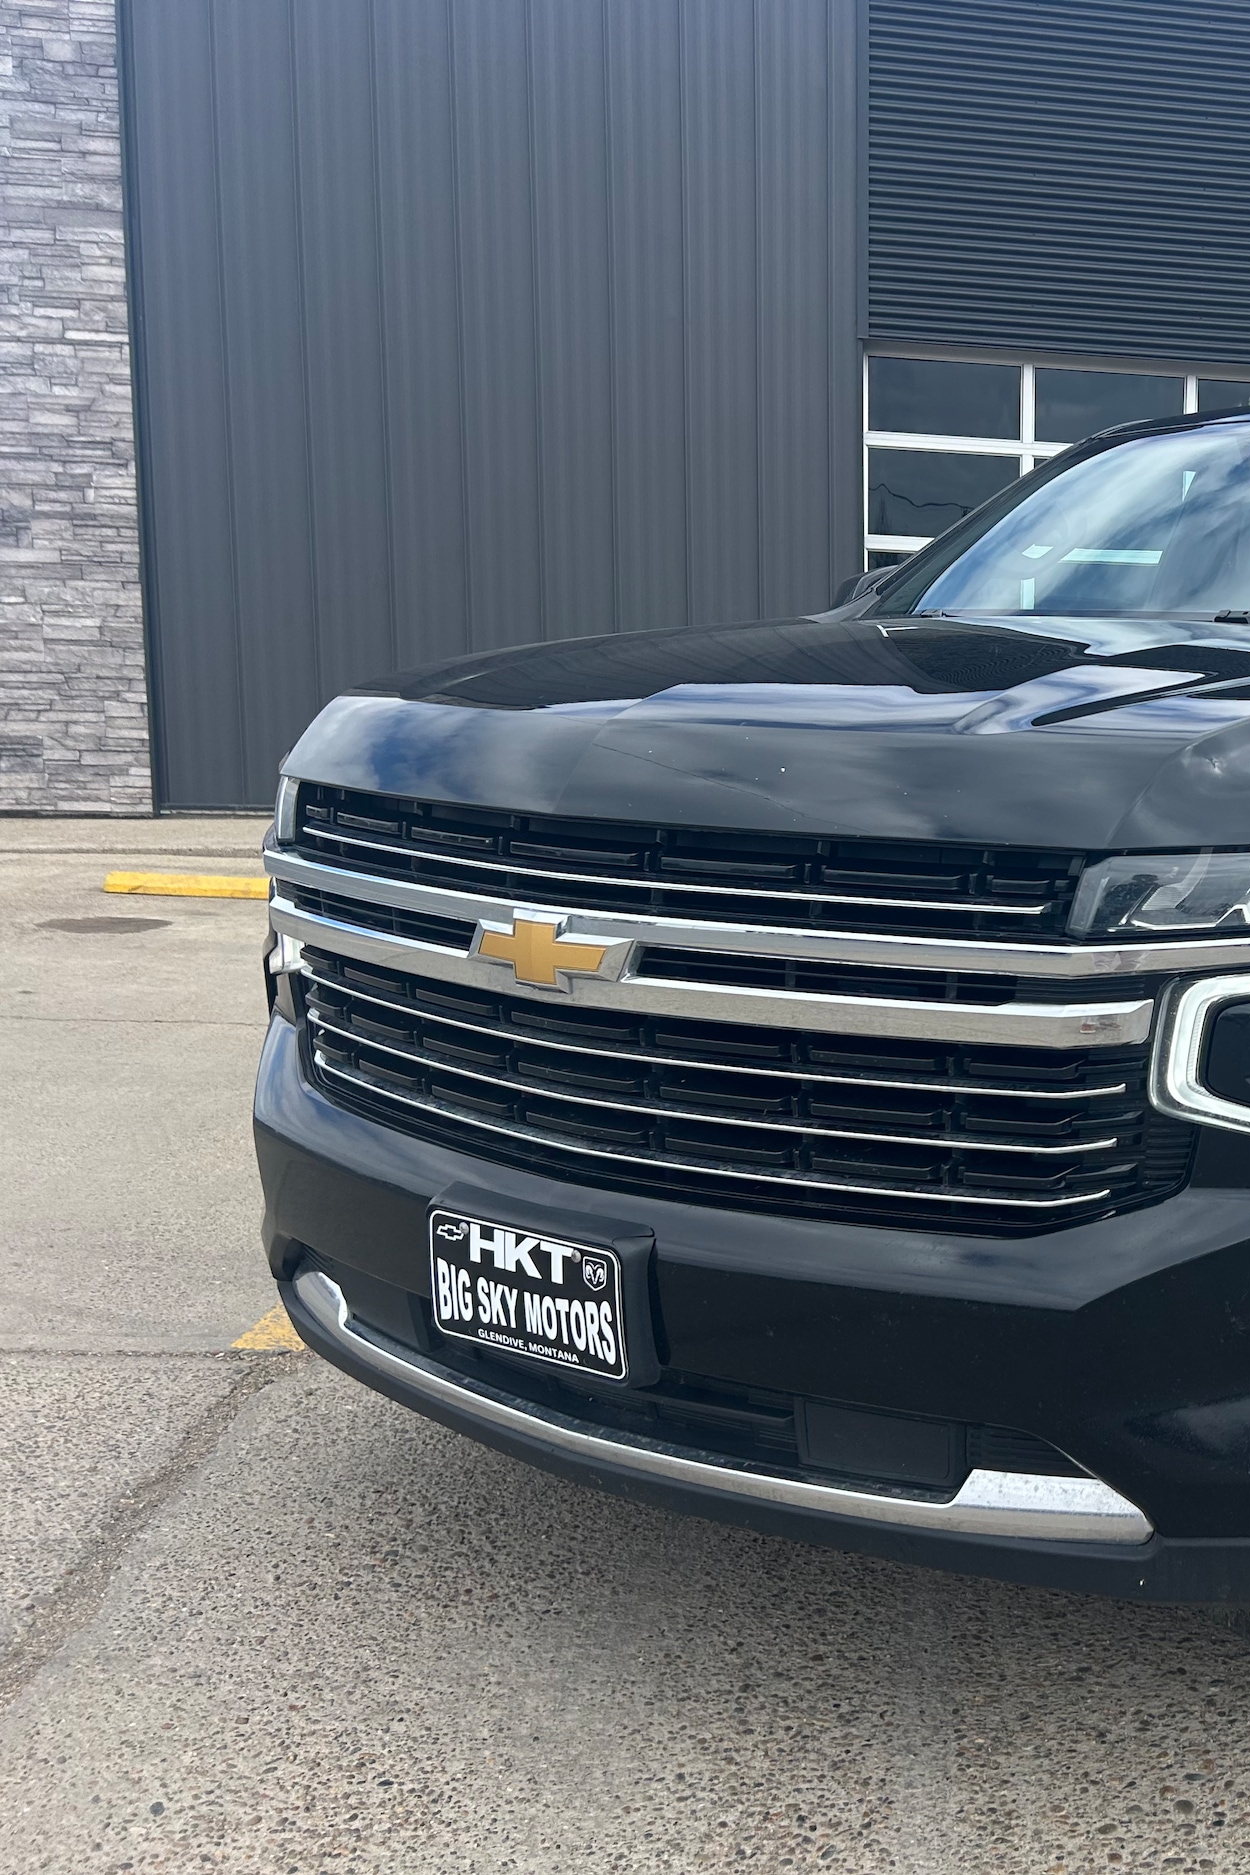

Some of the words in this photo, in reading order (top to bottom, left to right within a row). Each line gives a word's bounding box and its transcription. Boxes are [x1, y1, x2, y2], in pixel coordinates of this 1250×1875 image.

[469, 1222, 574, 1285] HKT
[436, 1257, 474, 1322] BIG
[477, 1276, 518, 1329] SKY
[524, 1291, 616, 1366] MOTORS
[478, 1328, 528, 1351] GLENDIVE,
[528, 1342, 580, 1364] MONTANA
